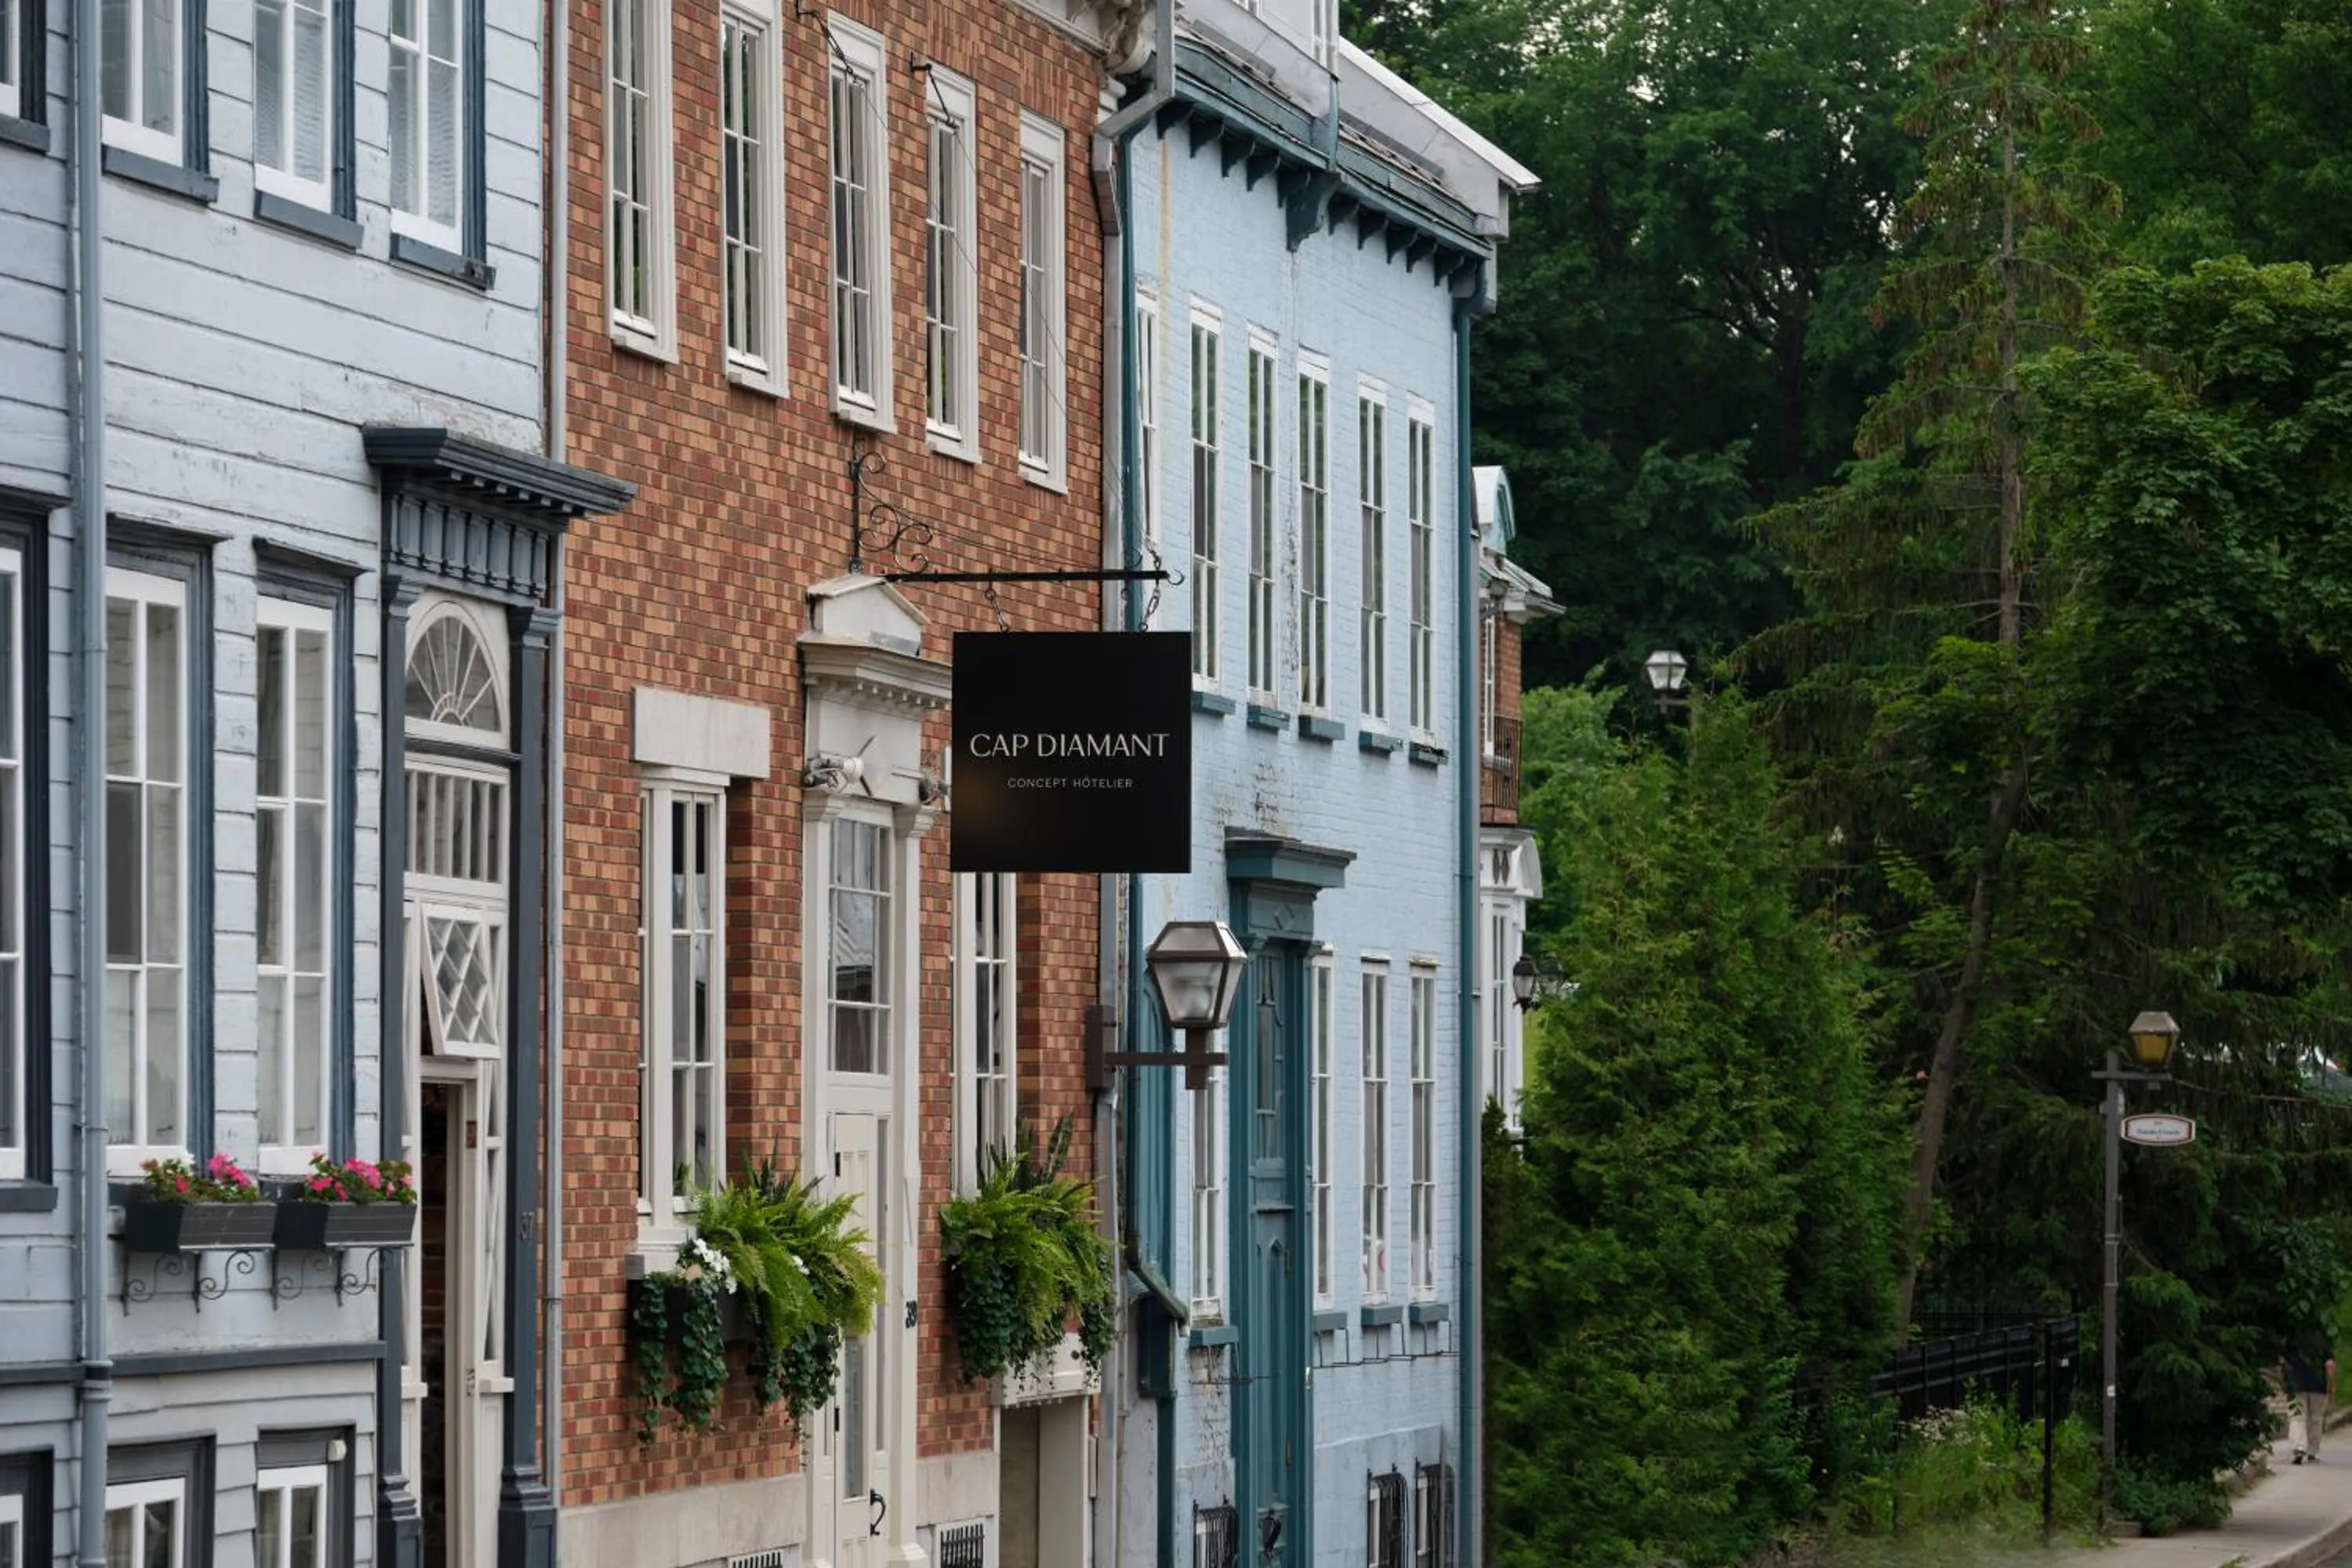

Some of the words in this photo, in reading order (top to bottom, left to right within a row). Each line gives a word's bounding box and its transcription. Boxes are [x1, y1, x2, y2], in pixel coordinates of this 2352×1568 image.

[970, 733, 1029, 757] CAP
[1037, 733, 1170, 757] DIAMANT
[1007, 778, 1067, 788] CONCEPT
[1073, 776, 1133, 788] HÔTELIER
